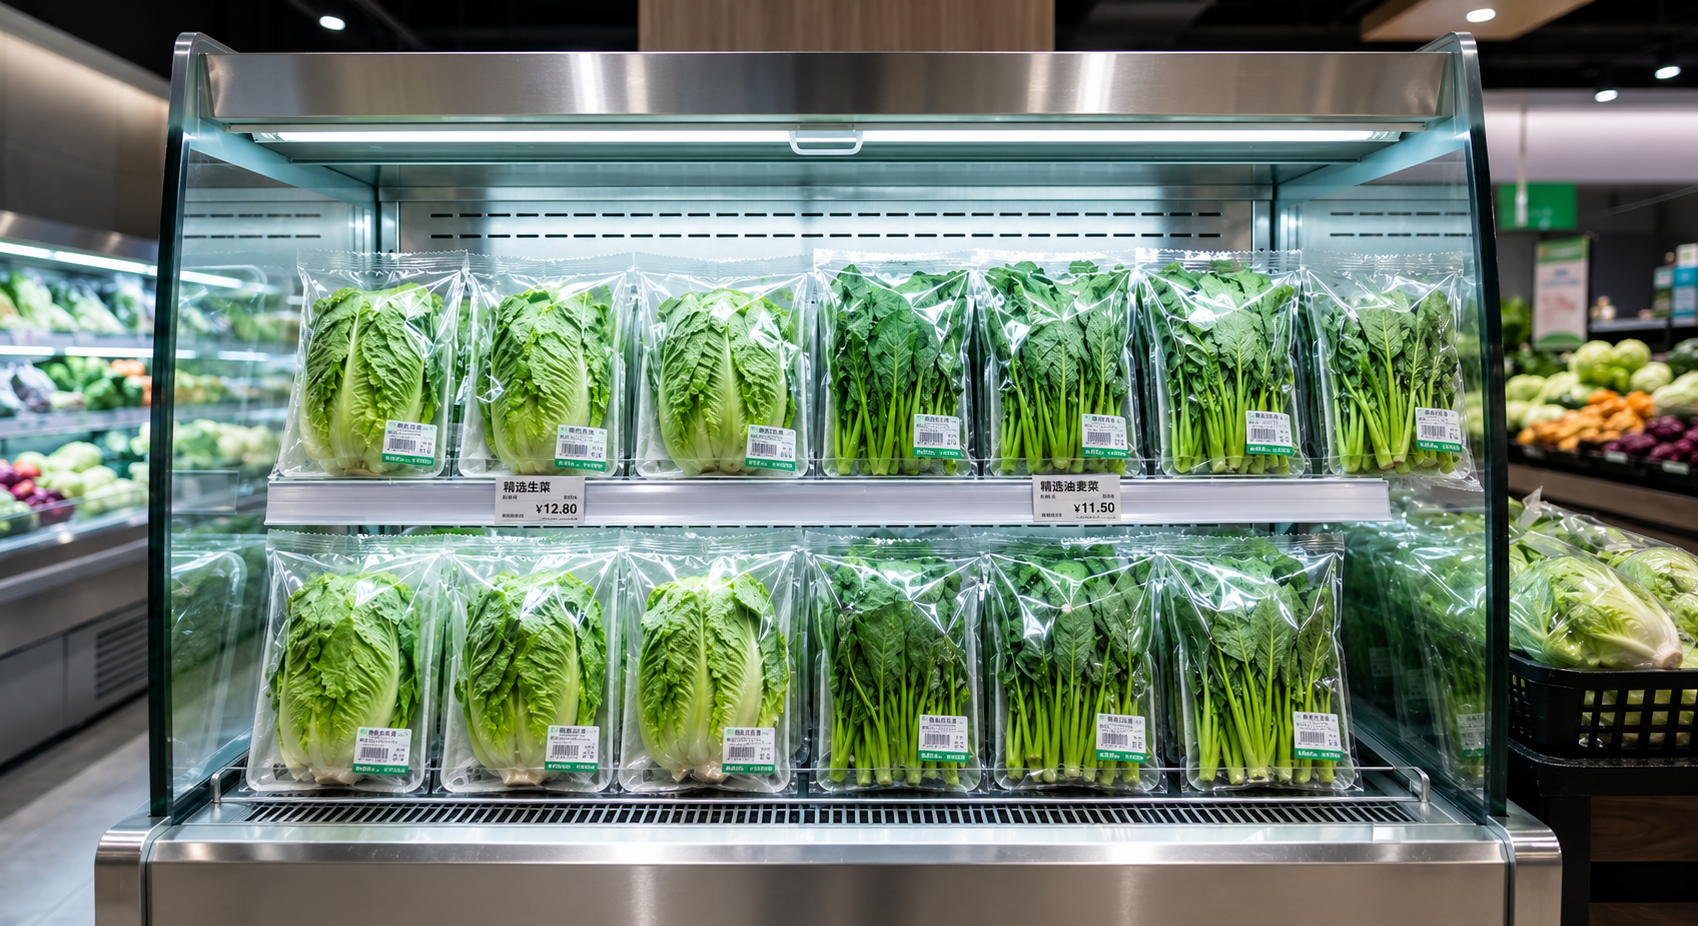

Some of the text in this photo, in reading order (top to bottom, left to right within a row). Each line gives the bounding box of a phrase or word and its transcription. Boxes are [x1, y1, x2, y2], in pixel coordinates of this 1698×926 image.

[503, 481, 551, 493] 精选生菜
[536, 503, 577, 514] ¥12.80
[1074, 502, 1115, 513] ¥11.50
